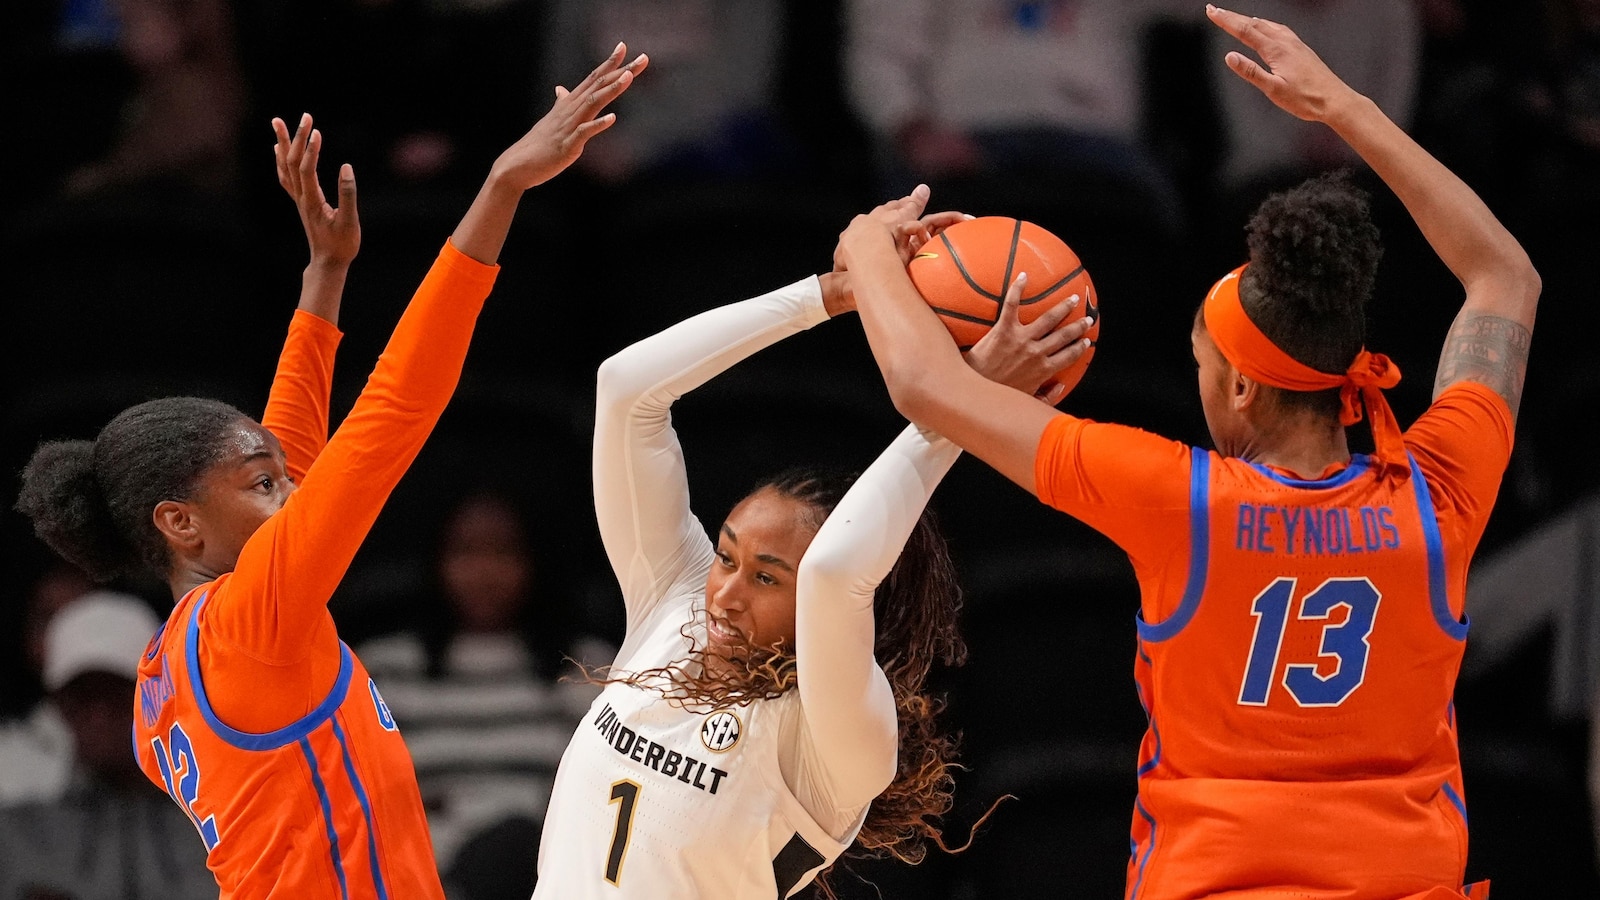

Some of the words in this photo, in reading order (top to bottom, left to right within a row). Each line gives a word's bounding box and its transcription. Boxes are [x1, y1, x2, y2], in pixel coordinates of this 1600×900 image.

[1236, 503, 1399, 554] REYNOLDS
[1237, 576, 1382, 707] 13
[593, 702, 728, 795] VANDERBILT
[701, 711, 741, 752] SEC
[151, 721, 220, 853] 12
[604, 778, 642, 888] 1
